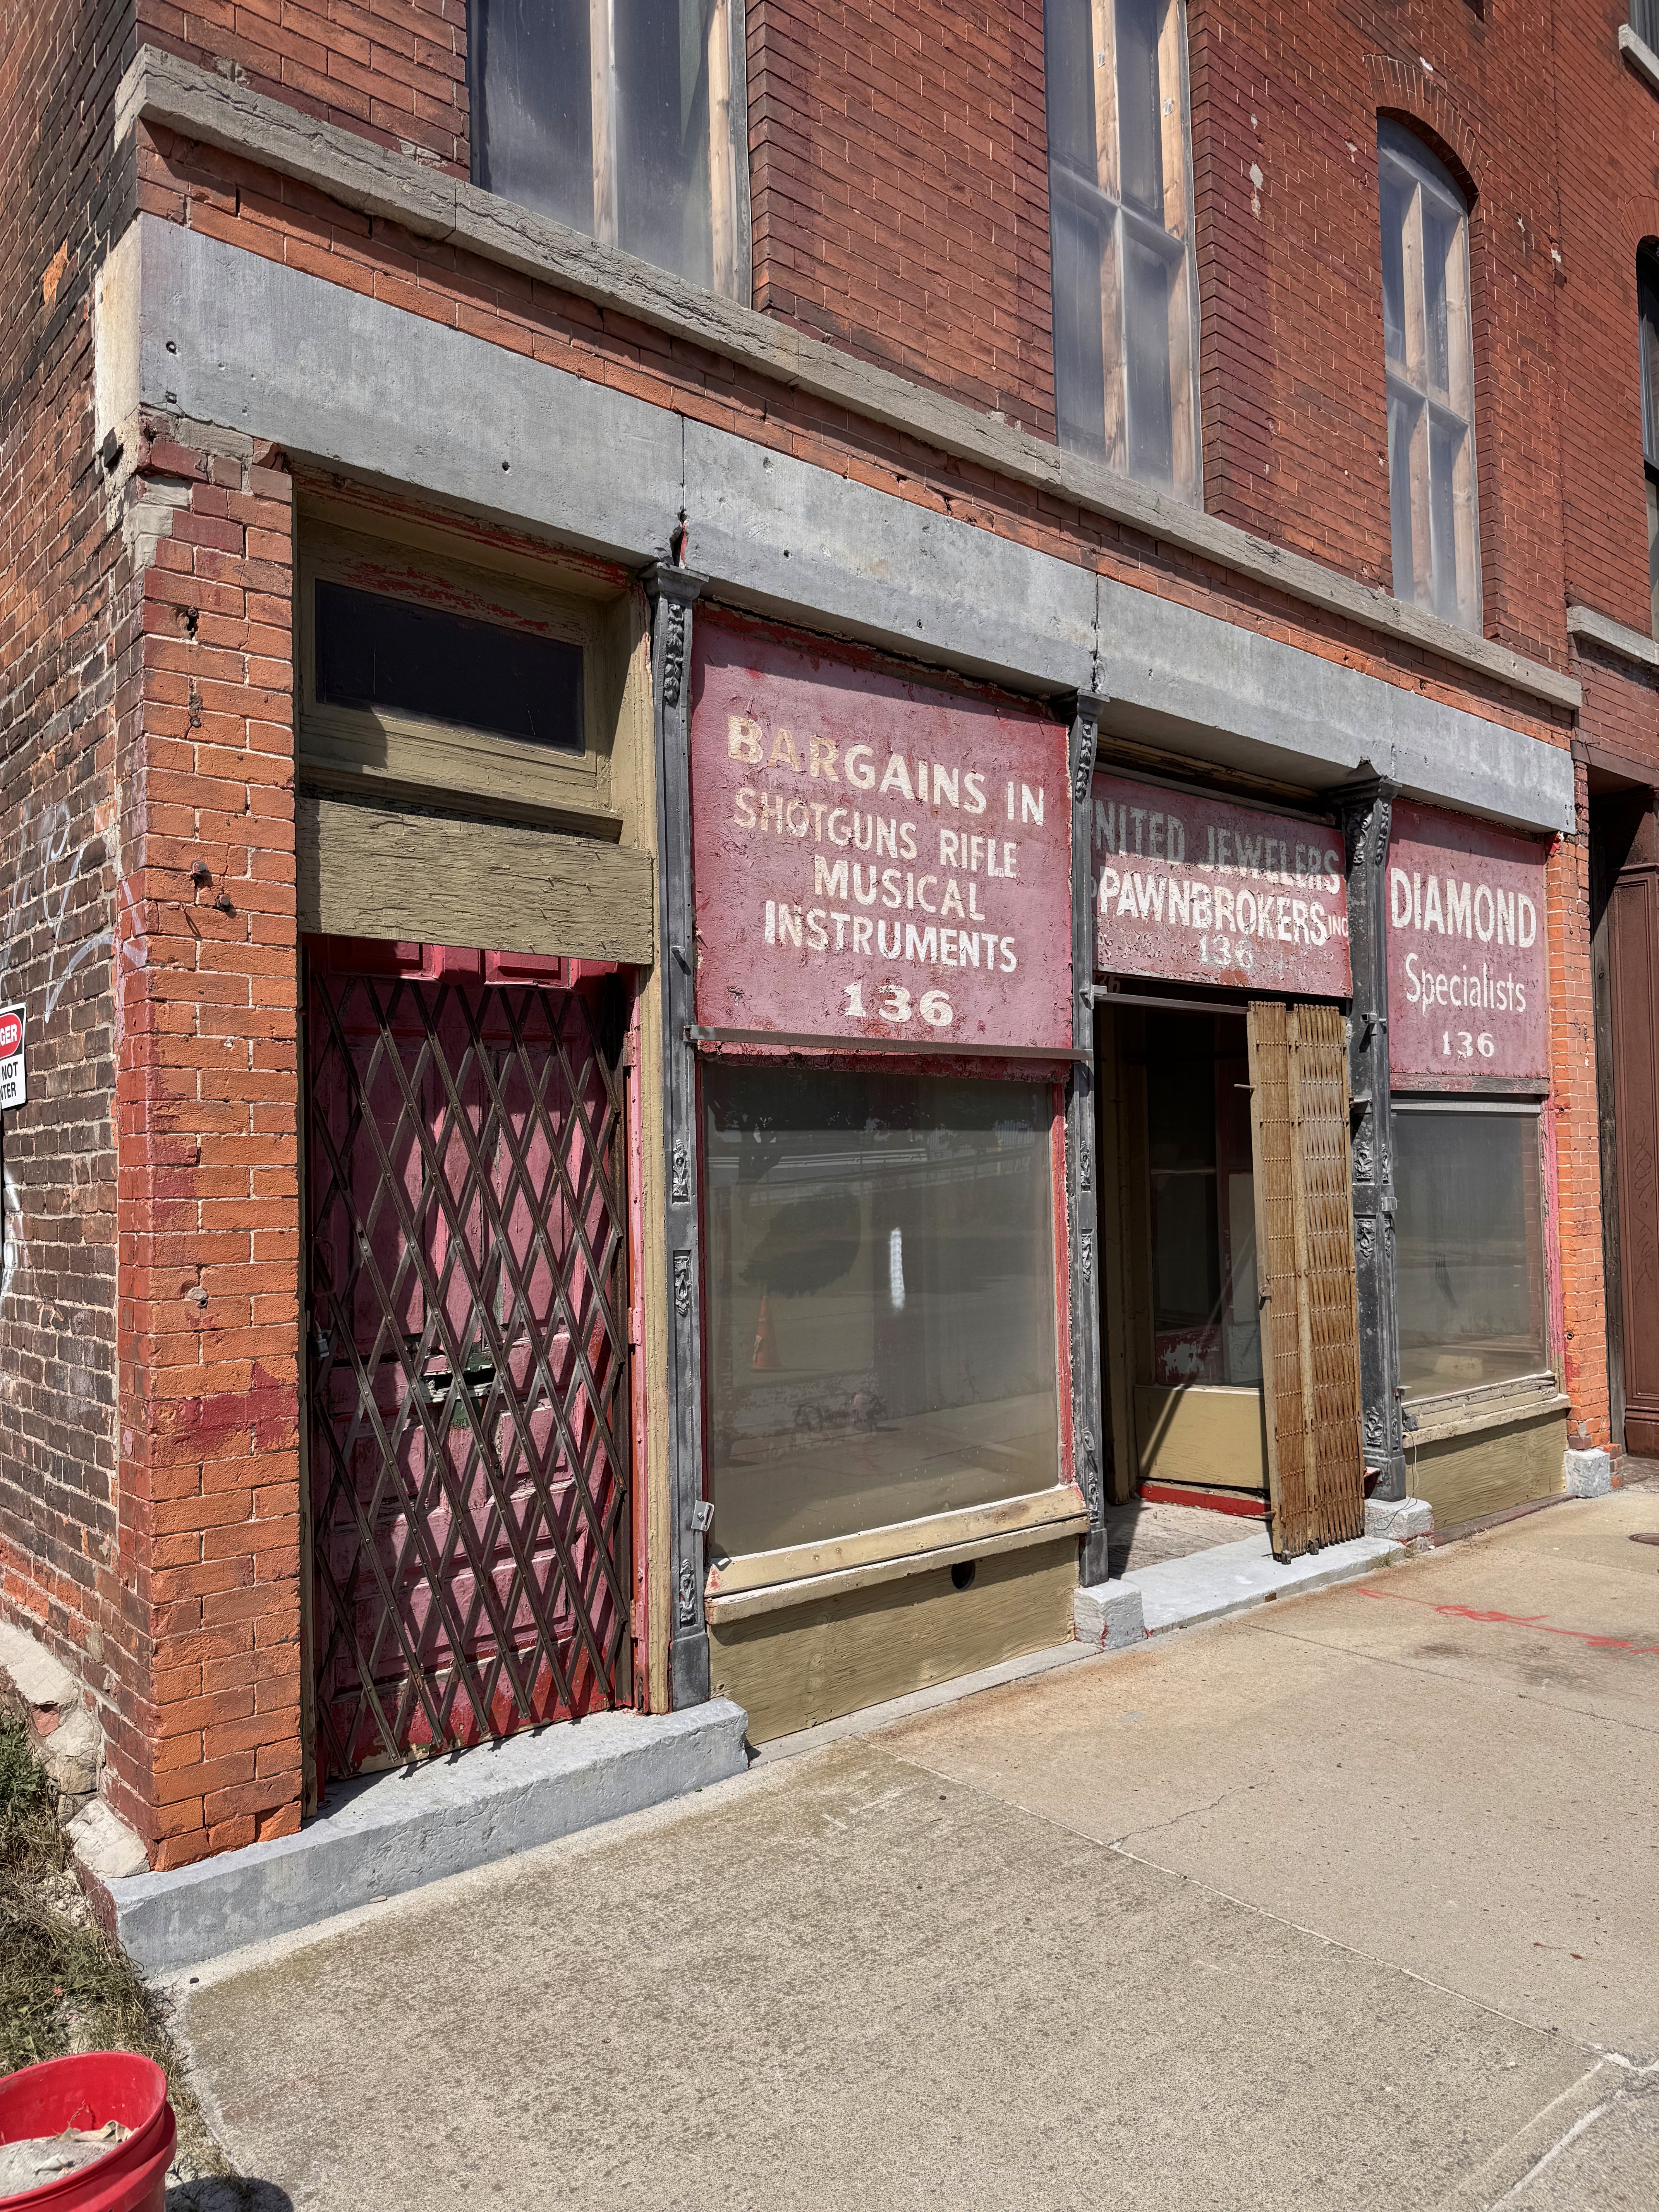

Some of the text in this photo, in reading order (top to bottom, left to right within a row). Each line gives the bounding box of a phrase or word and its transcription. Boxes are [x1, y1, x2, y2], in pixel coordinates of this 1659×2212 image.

[727, 714, 1044, 826] BARGAINS IN
[732, 787, 1017, 878] SHOTGUNS RIFLE
[1091, 798, 1341, 895] NITED JEWELERS
[814, 854, 986, 921] MUSICAL
[1099, 866, 1327, 946] PAWNBROKERS
[1391, 866, 1537, 948] DIAMOND
[764, 898, 1017, 973] INSTRUMENTS
[1199, 934, 1255, 969] 136
[842, 980, 953, 1027] 136
[1405, 952, 1527, 1017] Specialists
[0, 1024, 17, 1046] GER
[1442, 1030, 1495, 1061] 136
[2, 1061, 18, 1081] NOT
